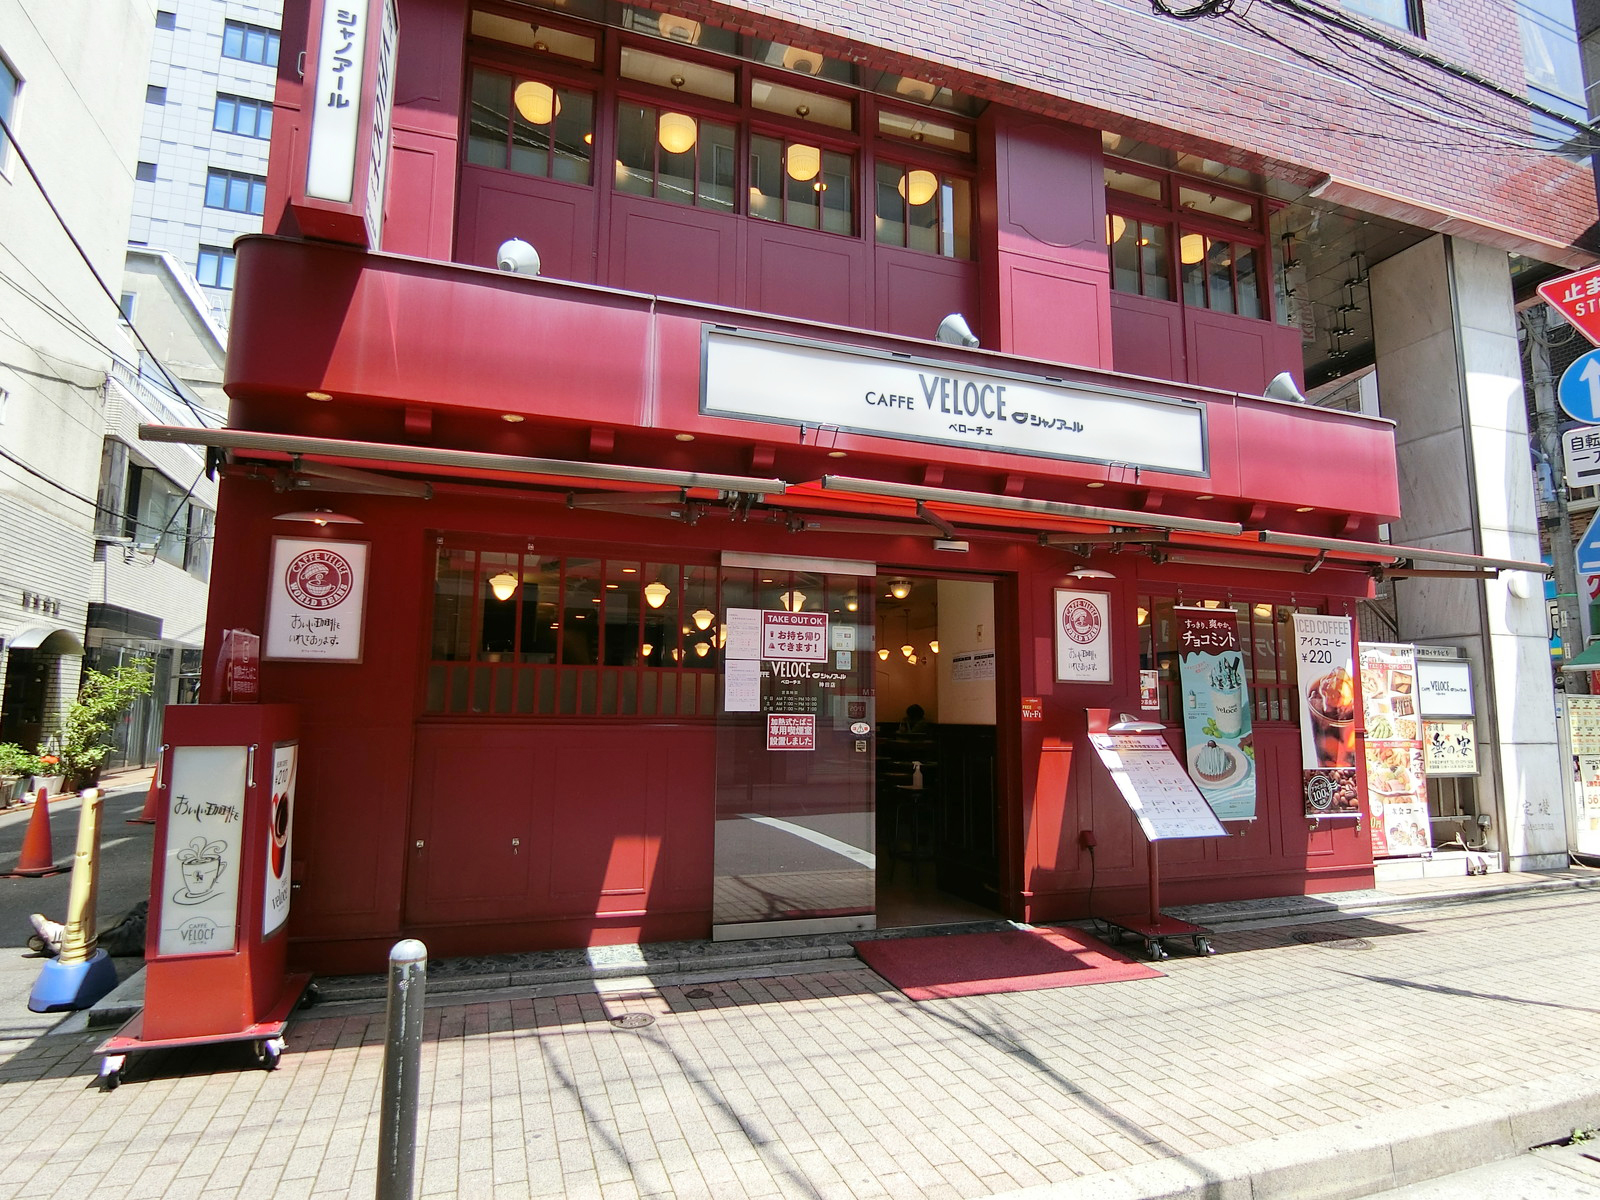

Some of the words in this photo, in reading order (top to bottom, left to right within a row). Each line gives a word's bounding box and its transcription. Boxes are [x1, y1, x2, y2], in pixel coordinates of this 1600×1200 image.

[328, 9, 357, 109] シャノアール
[1575, 297, 1600, 317] ST
[865, 391, 914, 410] CAFFE
[919, 373, 1007, 421] VELOCE
[948, 423, 993, 436] ベローチェ
[1030, 414, 1084, 433] シャノアール
[292, 553, 321, 574] CAFFE
[323, 553, 349, 576] VELOCE
[290, 581, 318, 606] WORLD
[321, 583, 348, 607] BEANS
[767, 615, 789, 624] TAKE
[791, 616, 809, 625] OUT
[810, 617, 823, 625] OK
[1295, 618, 1316, 633] ICED
[1316, 620, 1349, 636] COFFEE
[777, 630, 821, 641] お持ち帰り
[1182, 630, 1236, 647] チョコミント
[1300, 636, 1347, 647] アイスコーヒー
[1301, 649, 1332, 664] ¥220
[771, 661, 811, 678] VELOCE
[1430, 681, 1450, 691] VELOCE
[1022, 710, 1041, 718] Wi-Fi
[1588, 794, 1600, 804] 56
[181, 928, 215, 941] VELOCE
